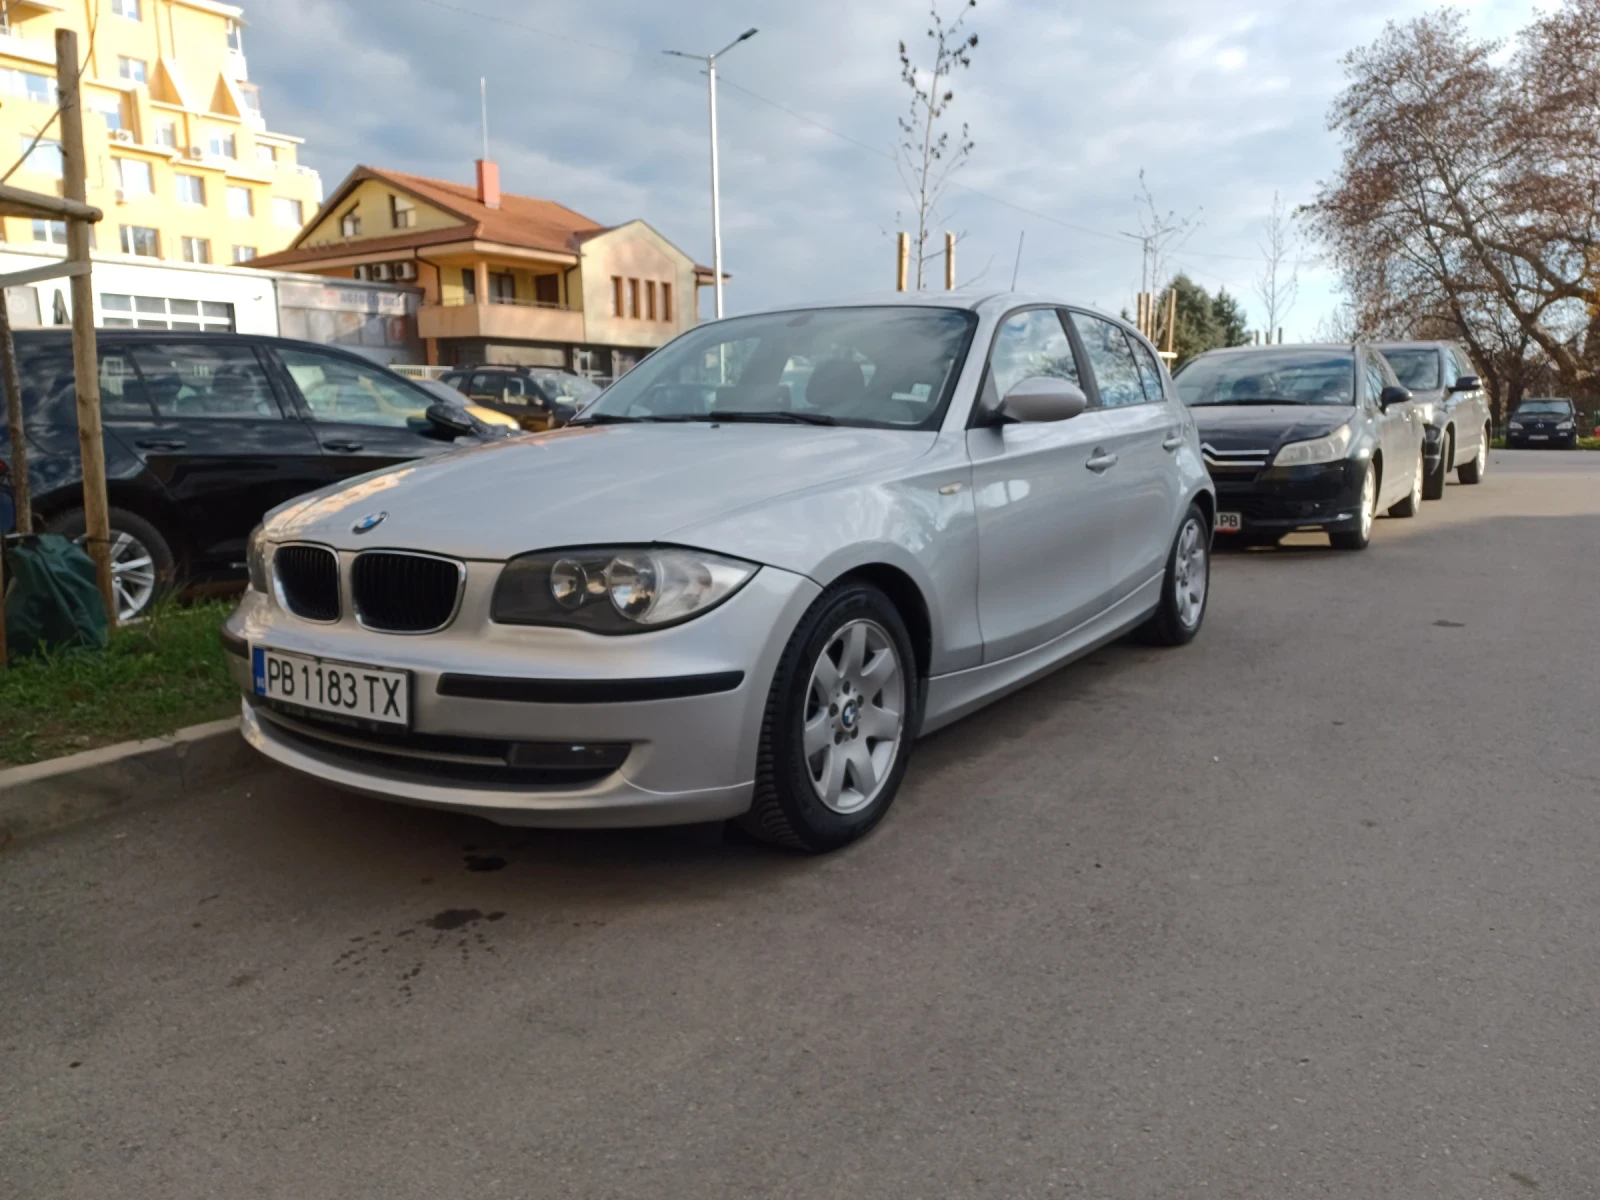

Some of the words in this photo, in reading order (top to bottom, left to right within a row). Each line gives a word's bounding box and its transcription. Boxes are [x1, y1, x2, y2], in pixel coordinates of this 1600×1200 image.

[1220, 515, 1238, 527] PB
[267, 657, 295, 696] PB
[301, 665, 358, 708] 1183
[363, 675, 401, 717] TX
